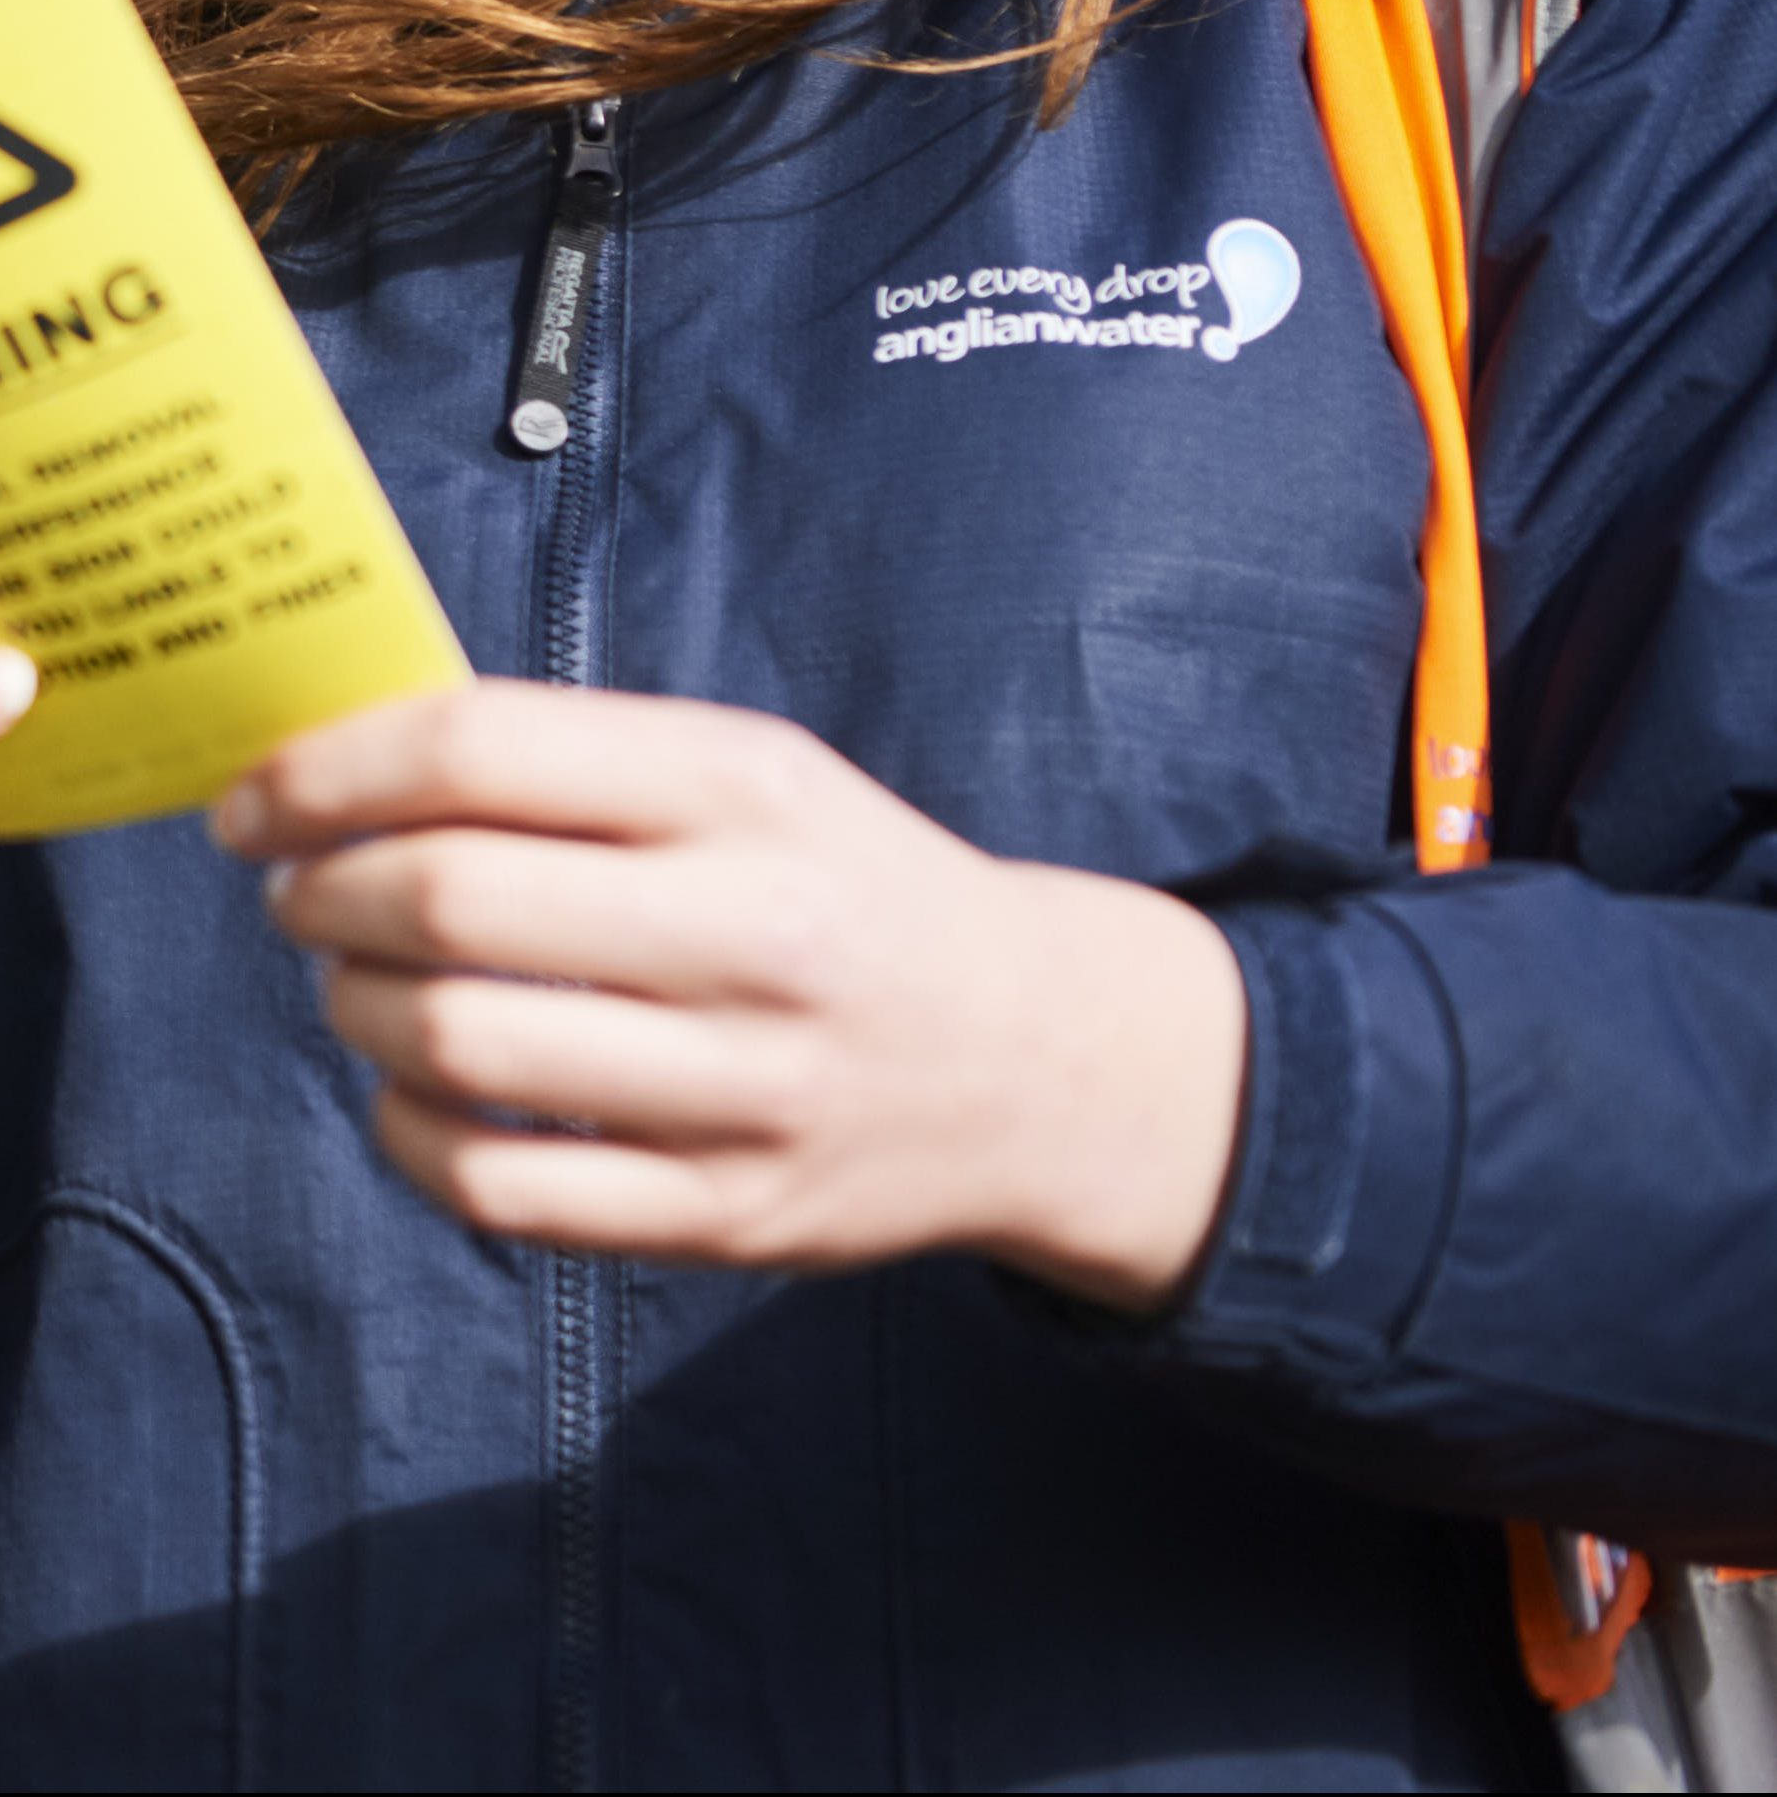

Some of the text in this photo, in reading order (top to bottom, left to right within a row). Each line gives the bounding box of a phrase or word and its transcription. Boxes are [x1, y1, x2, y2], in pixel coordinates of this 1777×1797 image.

[874, 262, 1210, 320] love every drop
[873, 307, 1203, 363] anglianwater
